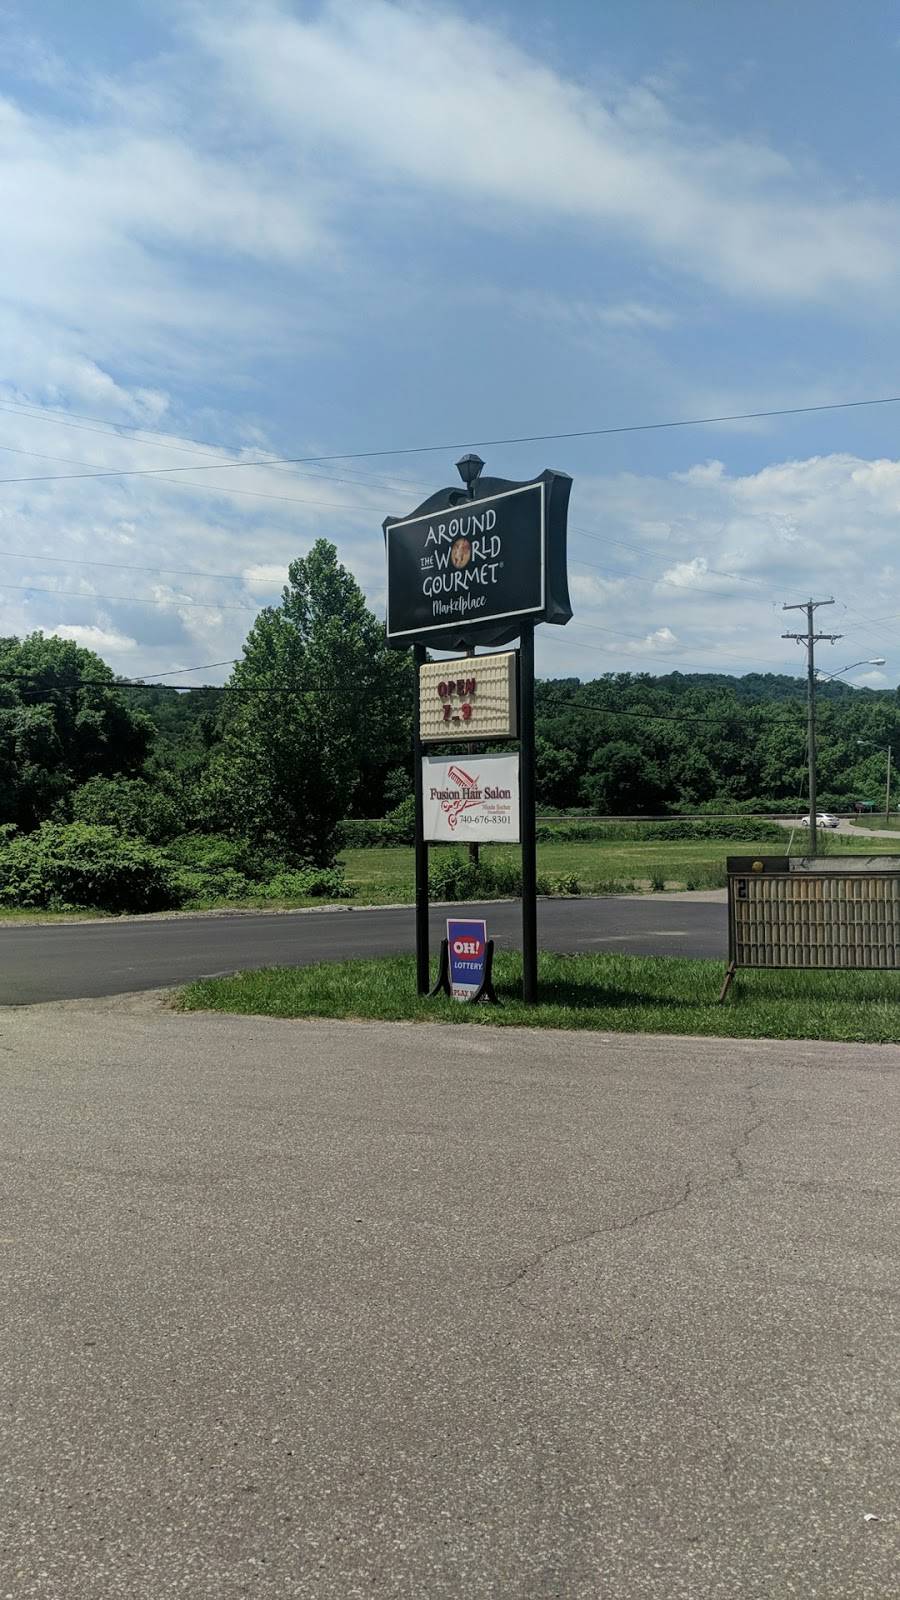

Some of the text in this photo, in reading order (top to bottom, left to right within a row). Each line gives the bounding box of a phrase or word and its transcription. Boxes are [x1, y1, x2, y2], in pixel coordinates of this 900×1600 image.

[424, 509, 497, 547] AROUND
[420, 555, 434, 570] THE
[422, 563, 499, 598] GOURMET
[432, 592, 487, 616] Marketplace
[437, 678, 476, 698] OPEN
[430, 787, 511, 800] Fusion Hair Salon
[460, 815, 511, 824] 740-676-8301
[453, 941, 480, 955] OH!
[454, 961, 483, 971] LOTTERY
